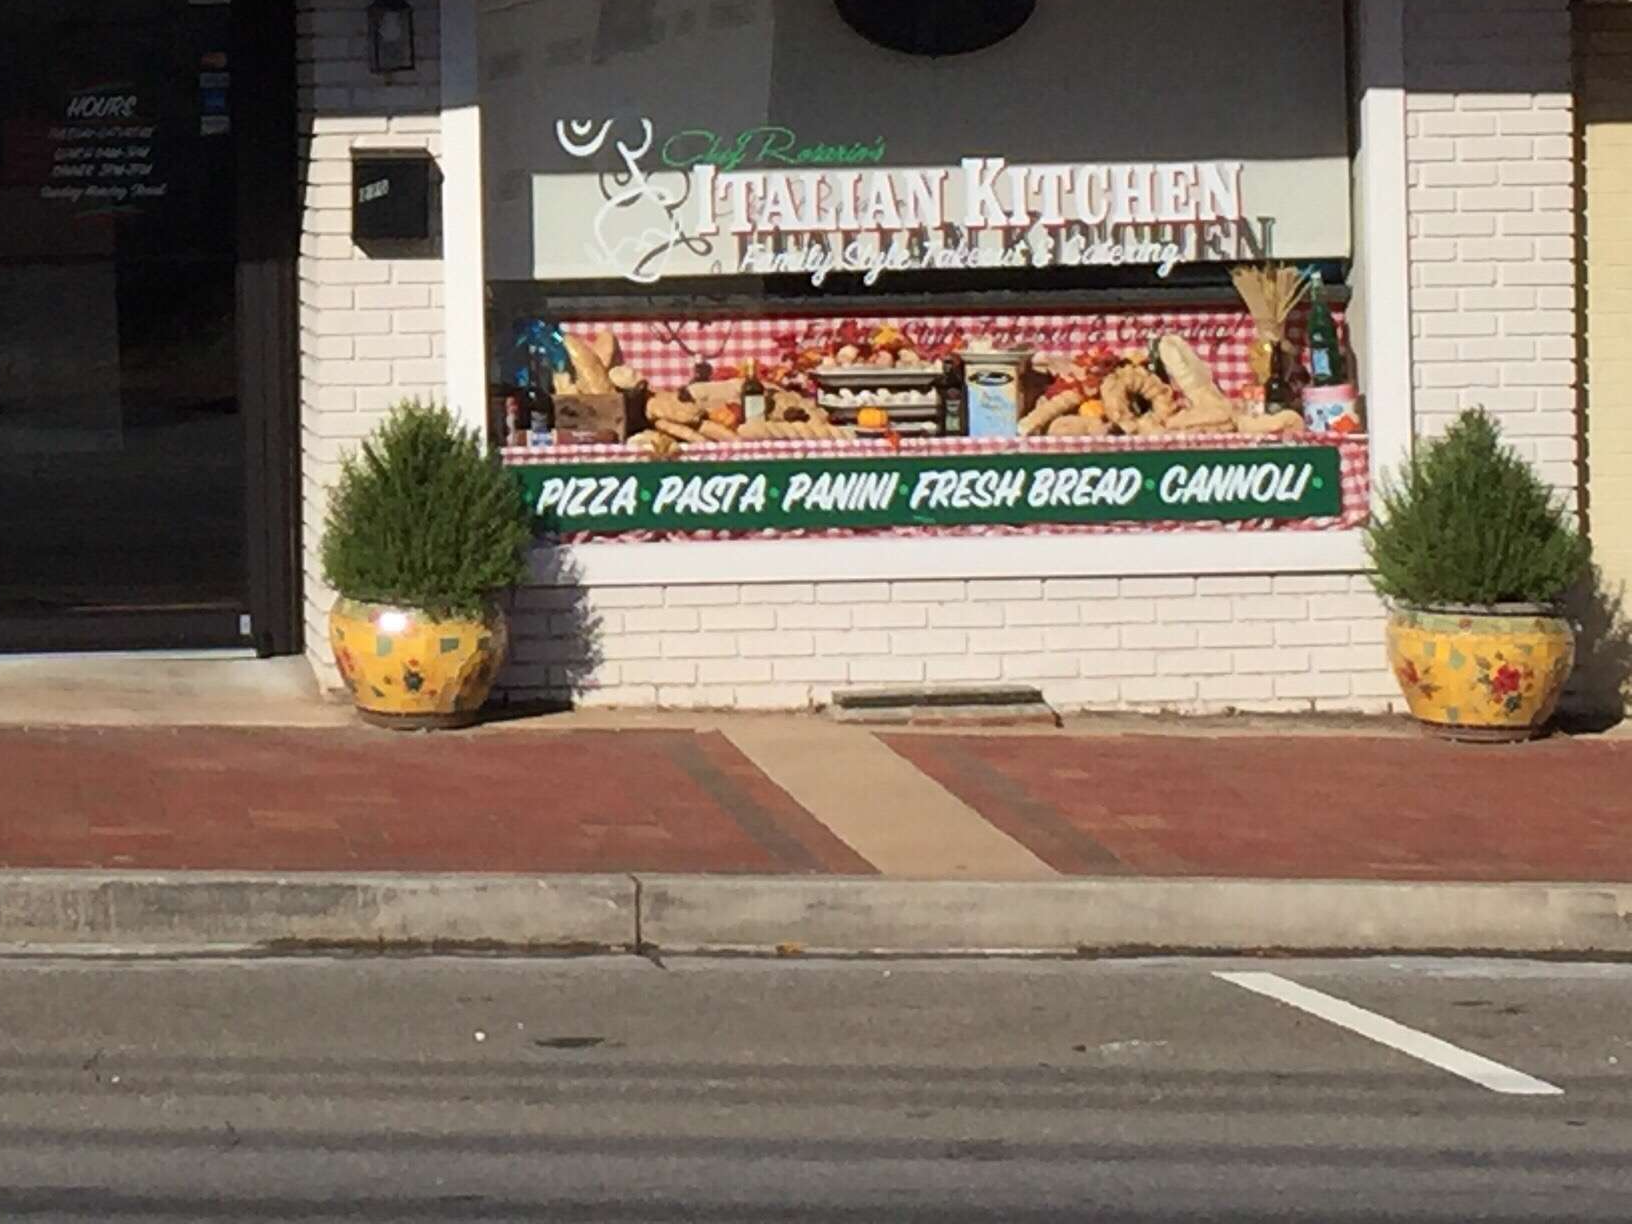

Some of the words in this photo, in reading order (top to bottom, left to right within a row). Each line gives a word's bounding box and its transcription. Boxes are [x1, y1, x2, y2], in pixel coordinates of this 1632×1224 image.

[67, 94, 138, 118] HOURS
[692, 163, 949, 236] ITALIAN
[961, 156, 1244, 228] KITCHEN
[535, 475, 640, 518] PIZZA
[651, 473, 767, 514] PASTA
[780, 470, 901, 512] PANINI
[908, 468, 1025, 509] FRESH
[1026, 466, 1143, 508] BREAD
[1158, 462, 1314, 504] CANNOLI
